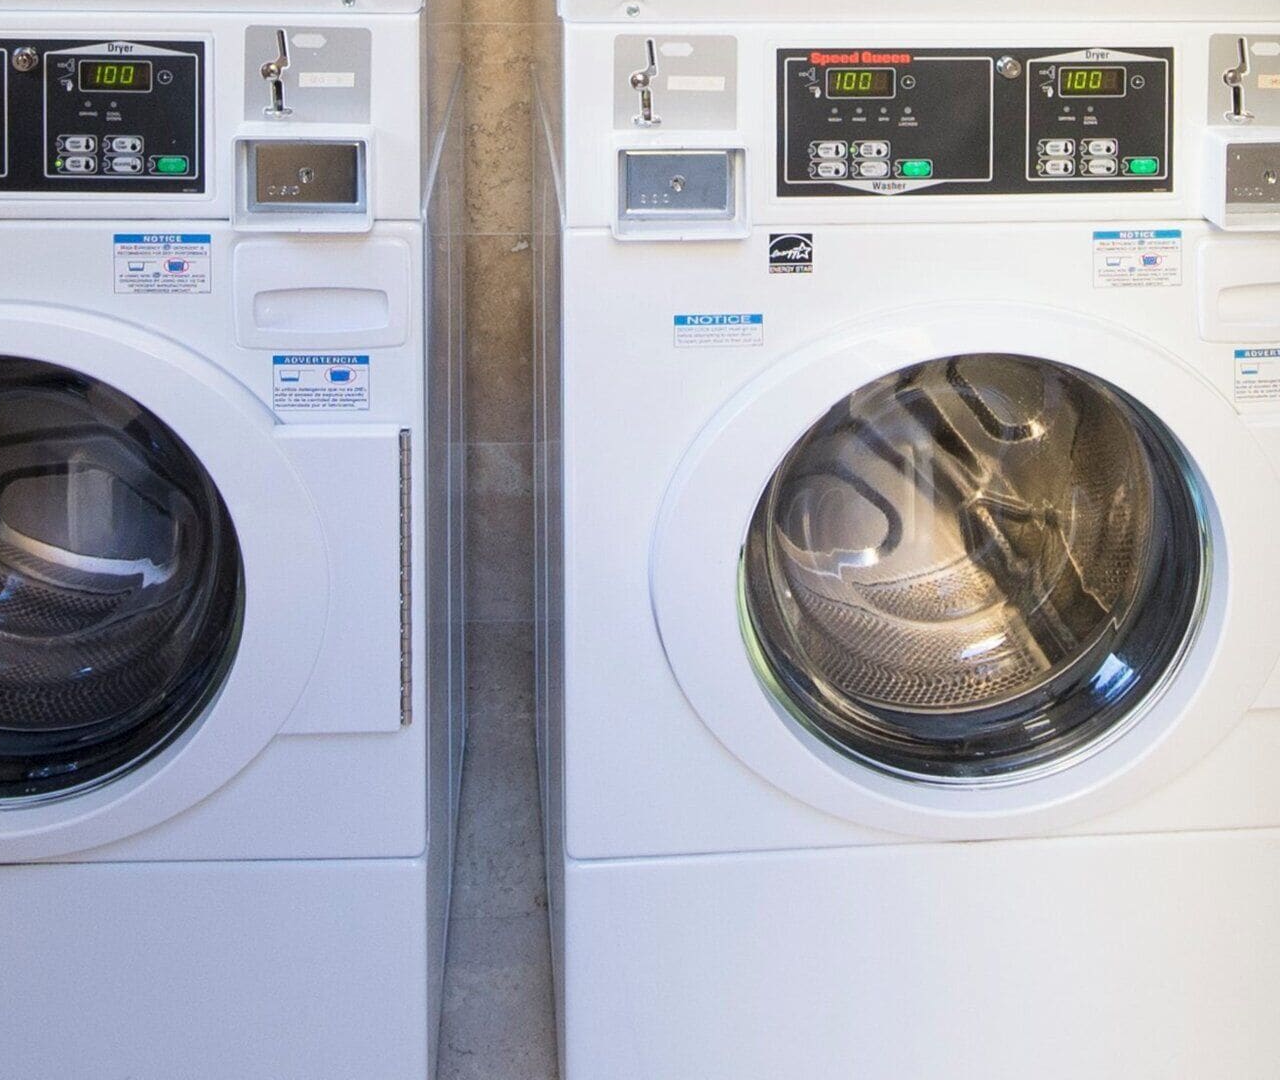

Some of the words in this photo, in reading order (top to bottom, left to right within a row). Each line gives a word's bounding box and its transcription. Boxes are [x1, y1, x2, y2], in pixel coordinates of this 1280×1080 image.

[107, 43, 134, 53] Dryer
[810, 52, 860, 66] Speed
[862, 51, 911, 64] Queen
[1085, 50, 1110, 60] Dryer
[96, 66, 134, 84] 100
[1066, 71, 1102, 89] 100
[835, 72, 872, 90] 100
[872, 181, 906, 190] Washer
[143, 235, 182, 243] NOTICE
[687, 315, 752, 324] NOTICE
